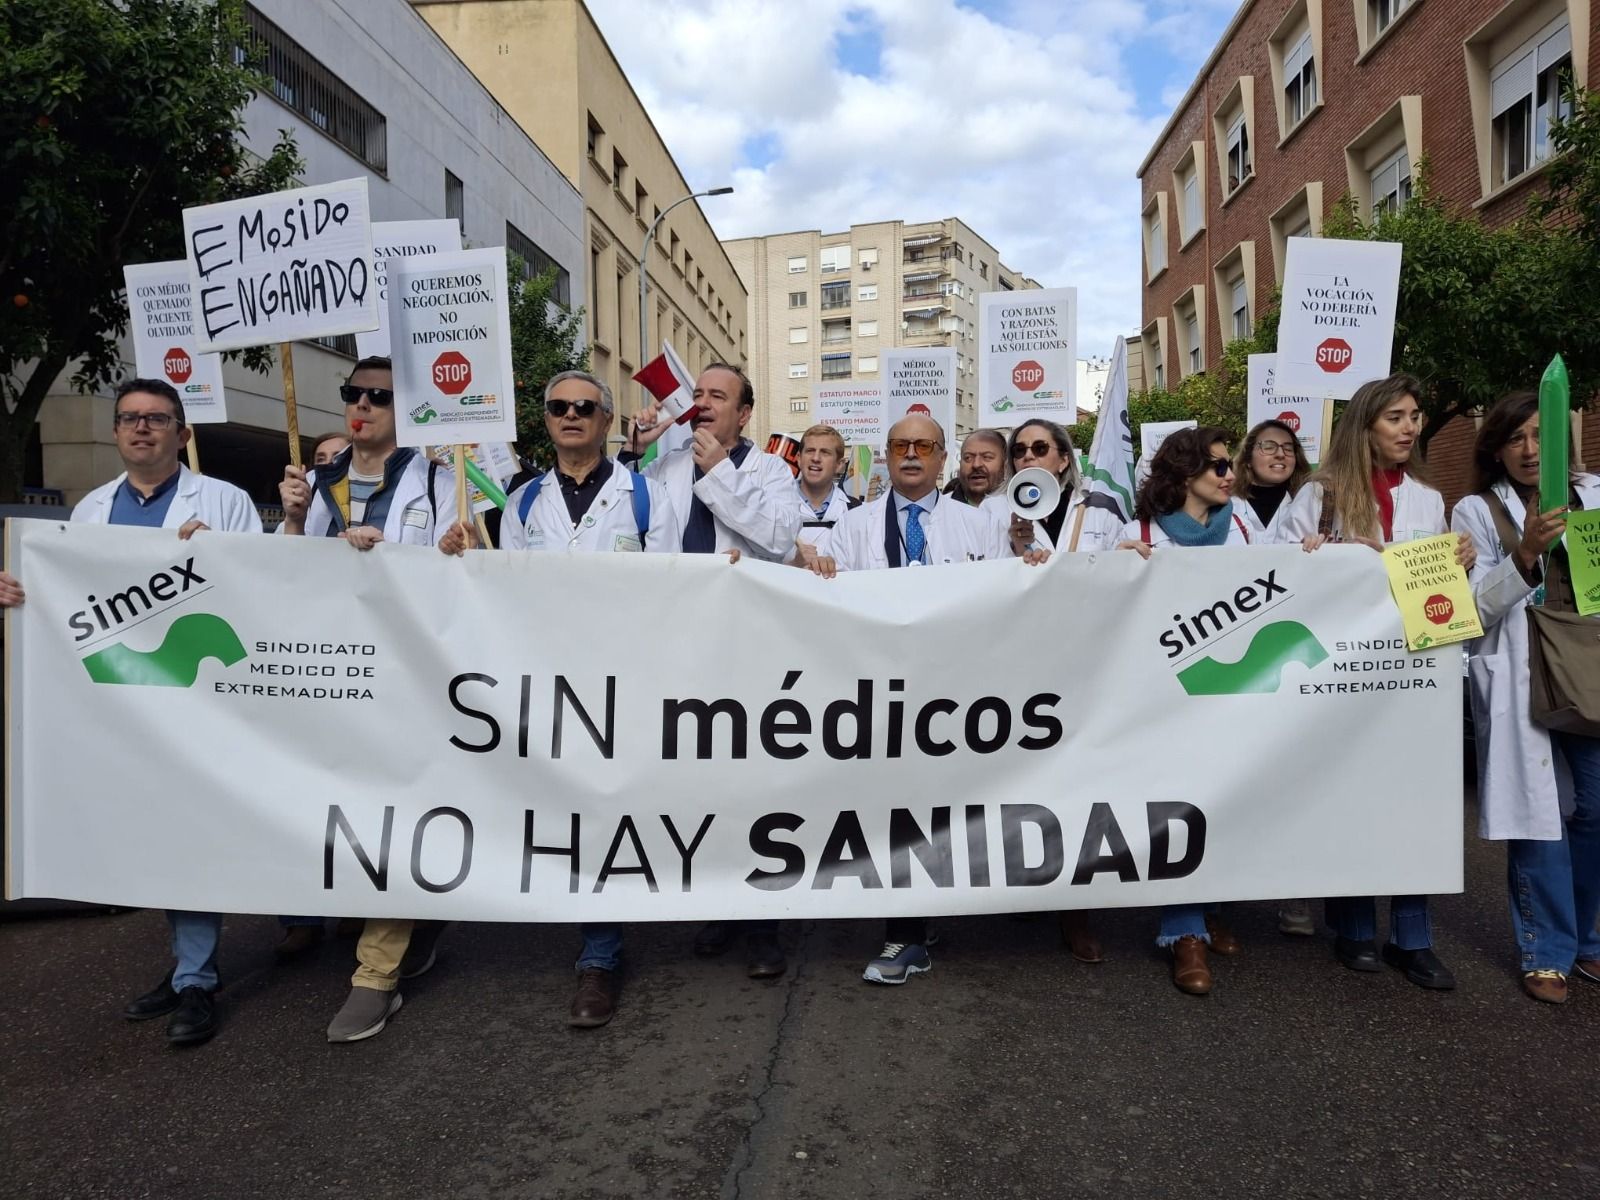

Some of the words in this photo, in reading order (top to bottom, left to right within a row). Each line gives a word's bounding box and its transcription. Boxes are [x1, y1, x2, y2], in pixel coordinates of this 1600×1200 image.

[374, 245, 437, 258] SANIDAD
[411, 274, 482, 291] QUEREMOS
[1333, 276, 1349, 287] LA
[136, 286, 156, 298] CON
[201, 257, 367, 341] ENGAÑADO
[402, 289, 494, 309] NEGOCIACIÓN,
[1306, 287, 1375, 301] VOCACIÓN
[143, 297, 192, 312] QUEMADO
[1001, 308, 1023, 319] CON
[1024, 305, 1056, 318] BATAS
[1300, 301, 1321, 312] NO
[1322, 301, 1378, 315] DEBERÍA
[439, 311, 458, 325] NO
[1000, 320, 1009, 330] Y
[1010, 317, 1058, 330] RAZONES,
[1314, 315, 1361, 328] DOLER.
[412, 325, 488, 345] IMPOSICIÓN
[1001, 328, 1025, 342] AQUÍ
[1026, 327, 1058, 340] ESTÁN
[990, 342, 1008, 353] LAS
[1009, 339, 1068, 353] SOLUCIONES
[1318, 348, 1350, 363] STOP
[165, 358, 190, 373] STOP
[902, 358, 936, 369] MÉDICO
[435, 364, 469, 383] STOP
[1014, 370, 1042, 383] STOP
[899, 379, 940, 388] PACIENTE
[889, 388, 949, 398] ABANDONADO
[1267, 396, 1310, 405] CUIDADA
[409, 400, 431, 417] simex
[1574, 522, 1595, 534] NO
[1393, 549, 1411, 560] NO
[1412, 540, 1451, 555] SOMOS
[1403, 552, 1447, 569] HÉROES
[1410, 563, 1448, 579] SOMOS
[1406, 573, 1458, 592] HUMANOS
[68, 556, 207, 642] simex
[1159, 568, 1288, 659] simex
[1426, 601, 1451, 619] STOP
[255, 641, 376, 656] SINDICATO
[250, 663, 336, 677] MEDICO
[347, 665, 375, 678] DE
[1333, 659, 1405, 673] MEDICO
[1412, 657, 1437, 669] DE
[214, 682, 375, 700] EXTREMADURA
[1299, 678, 1437, 695] EXTREMADURA
[448, 672, 616, 760] SIN
[661, 670, 1064, 760] médicos
[323, 804, 475, 893] NO
[519, 808, 716, 894] HAY
[744, 801, 1207, 892] SANIDAD
